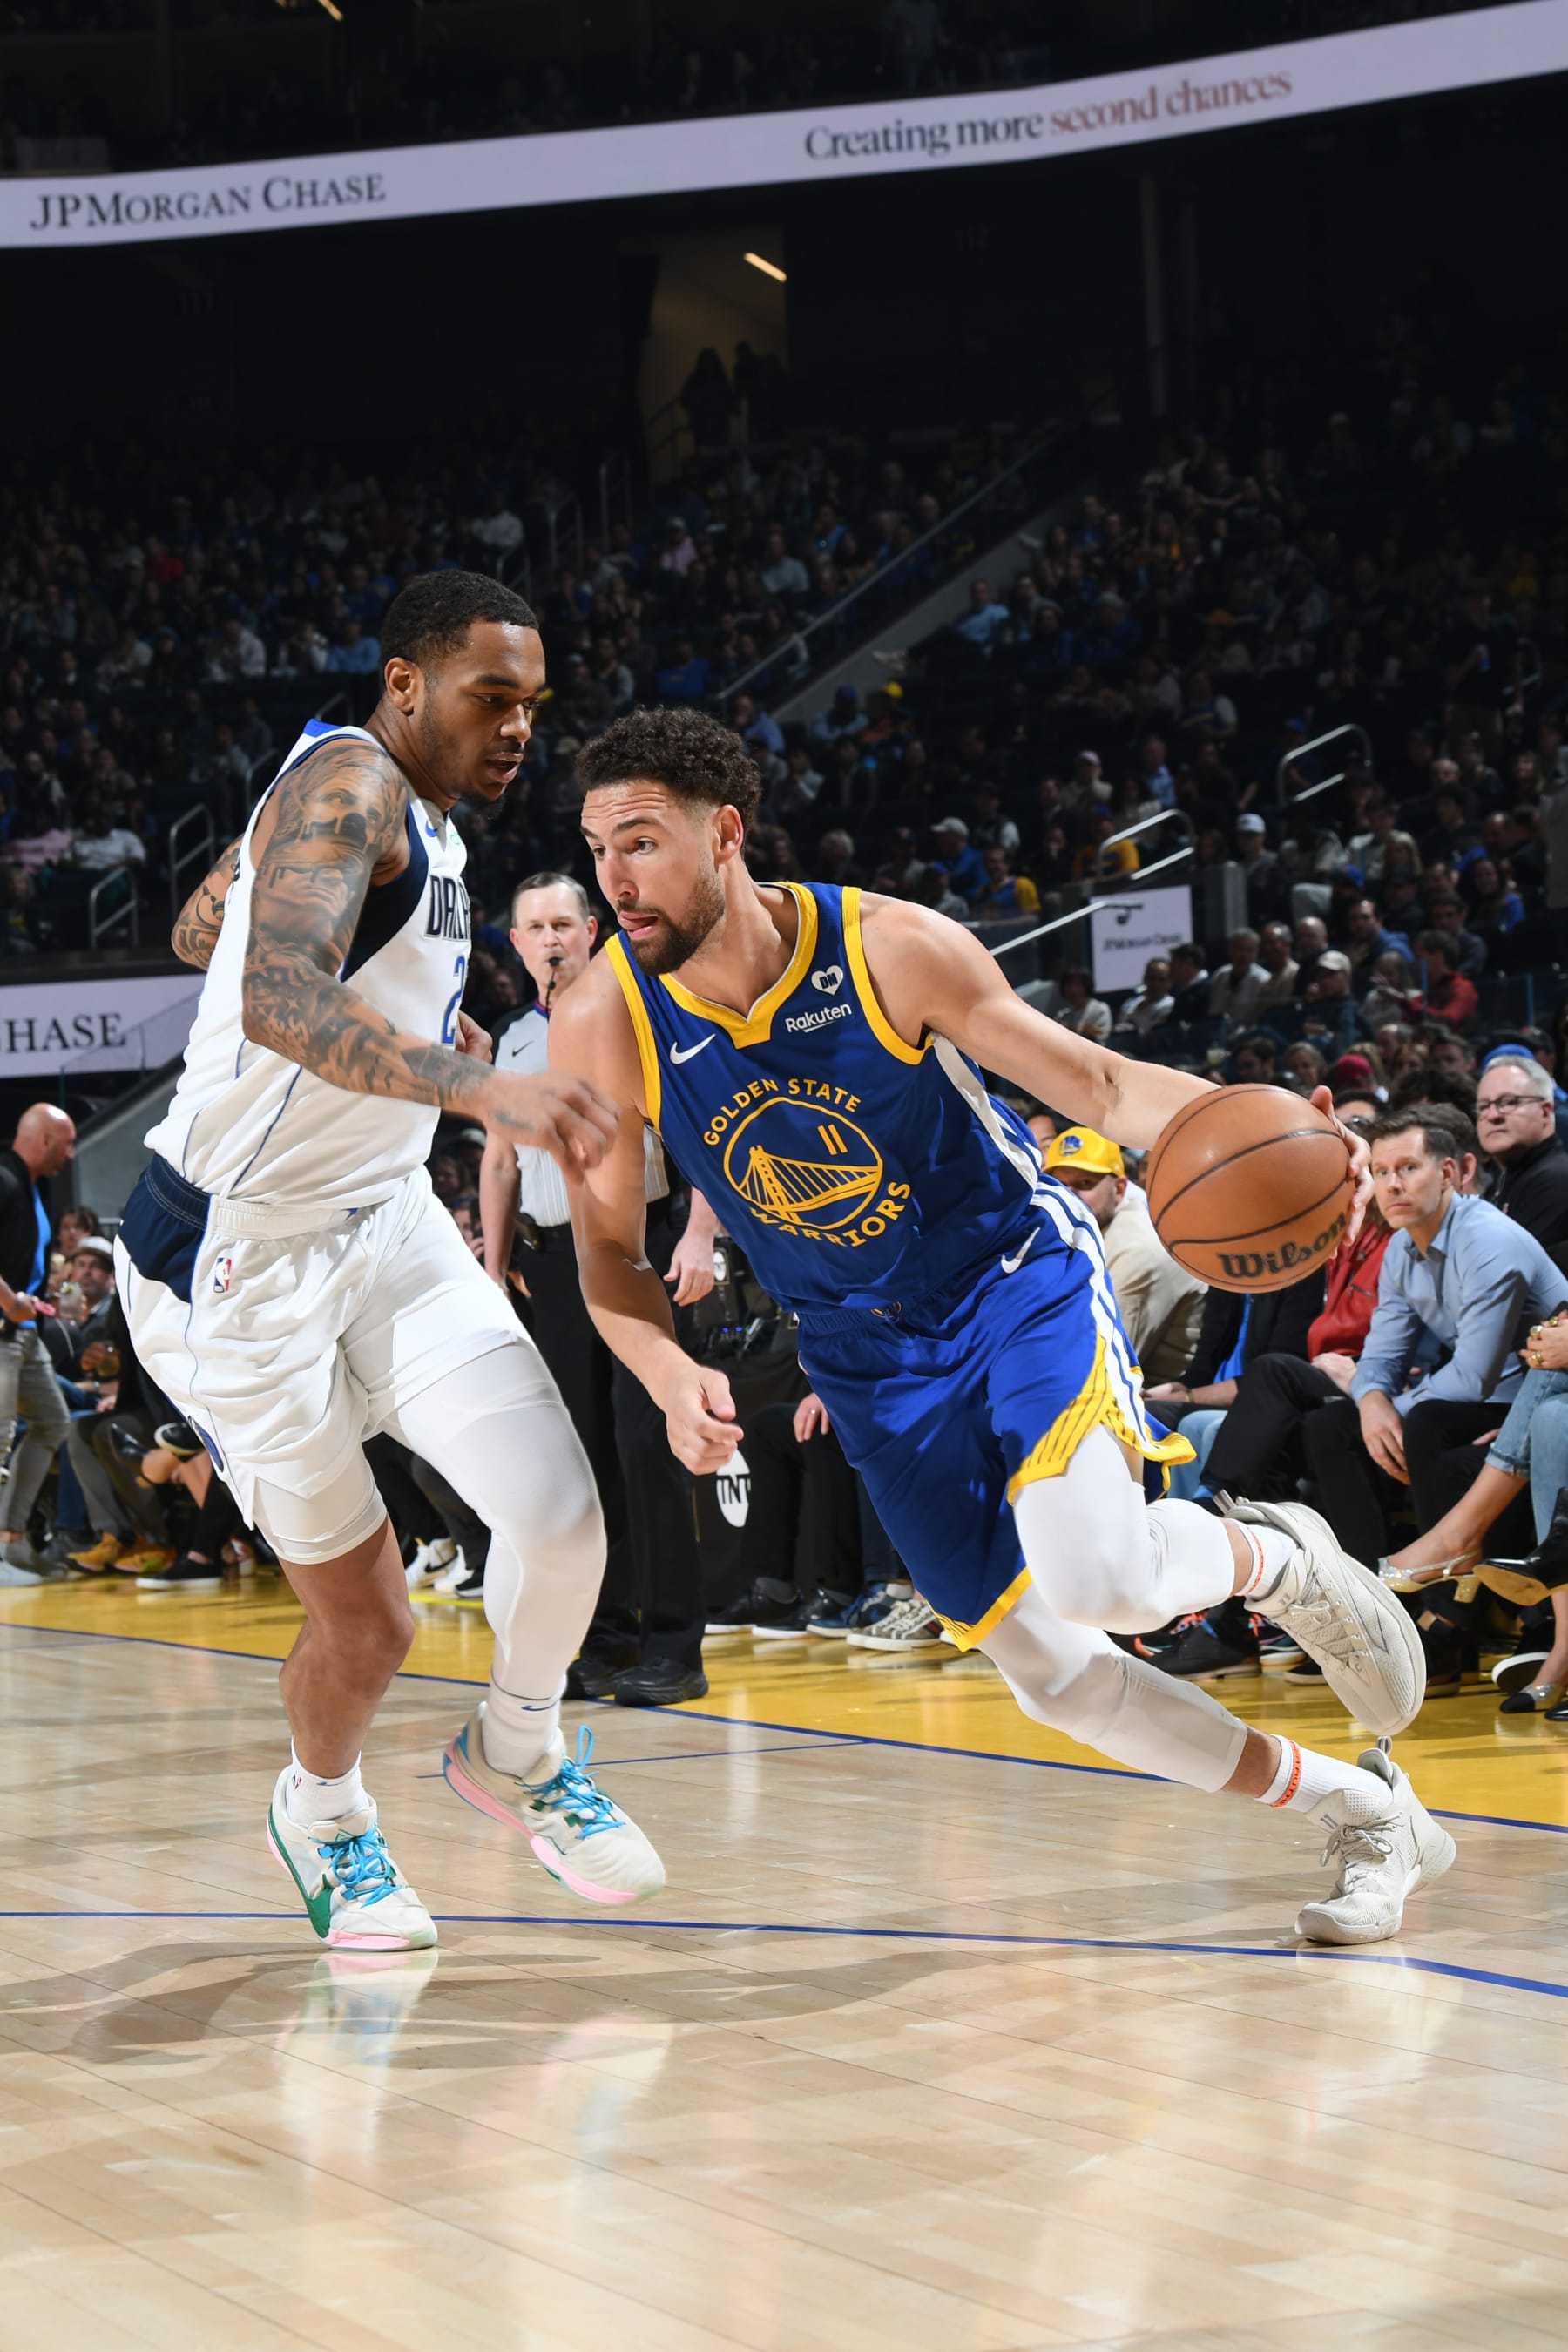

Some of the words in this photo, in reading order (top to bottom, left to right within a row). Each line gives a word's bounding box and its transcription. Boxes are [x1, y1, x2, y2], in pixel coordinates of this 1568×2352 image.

[805, 118, 951, 160] Creating
[957, 113, 1044, 146] more
[1050, 86, 1158, 135] second
[1166, 70, 1293, 118] chances
[819, 972, 839, 990] DM
[0, 1013, 127, 1053] HASE
[785, 1004, 852, 1033] Rakuten
[703, 1078, 779, 1146] GOLDEN
[788, 1078, 862, 1112] STATE
[817, 1124, 848, 1156] 11
[749, 1181, 911, 1247] WARRIORS
[1217, 1212, 1347, 1278] Wilson
